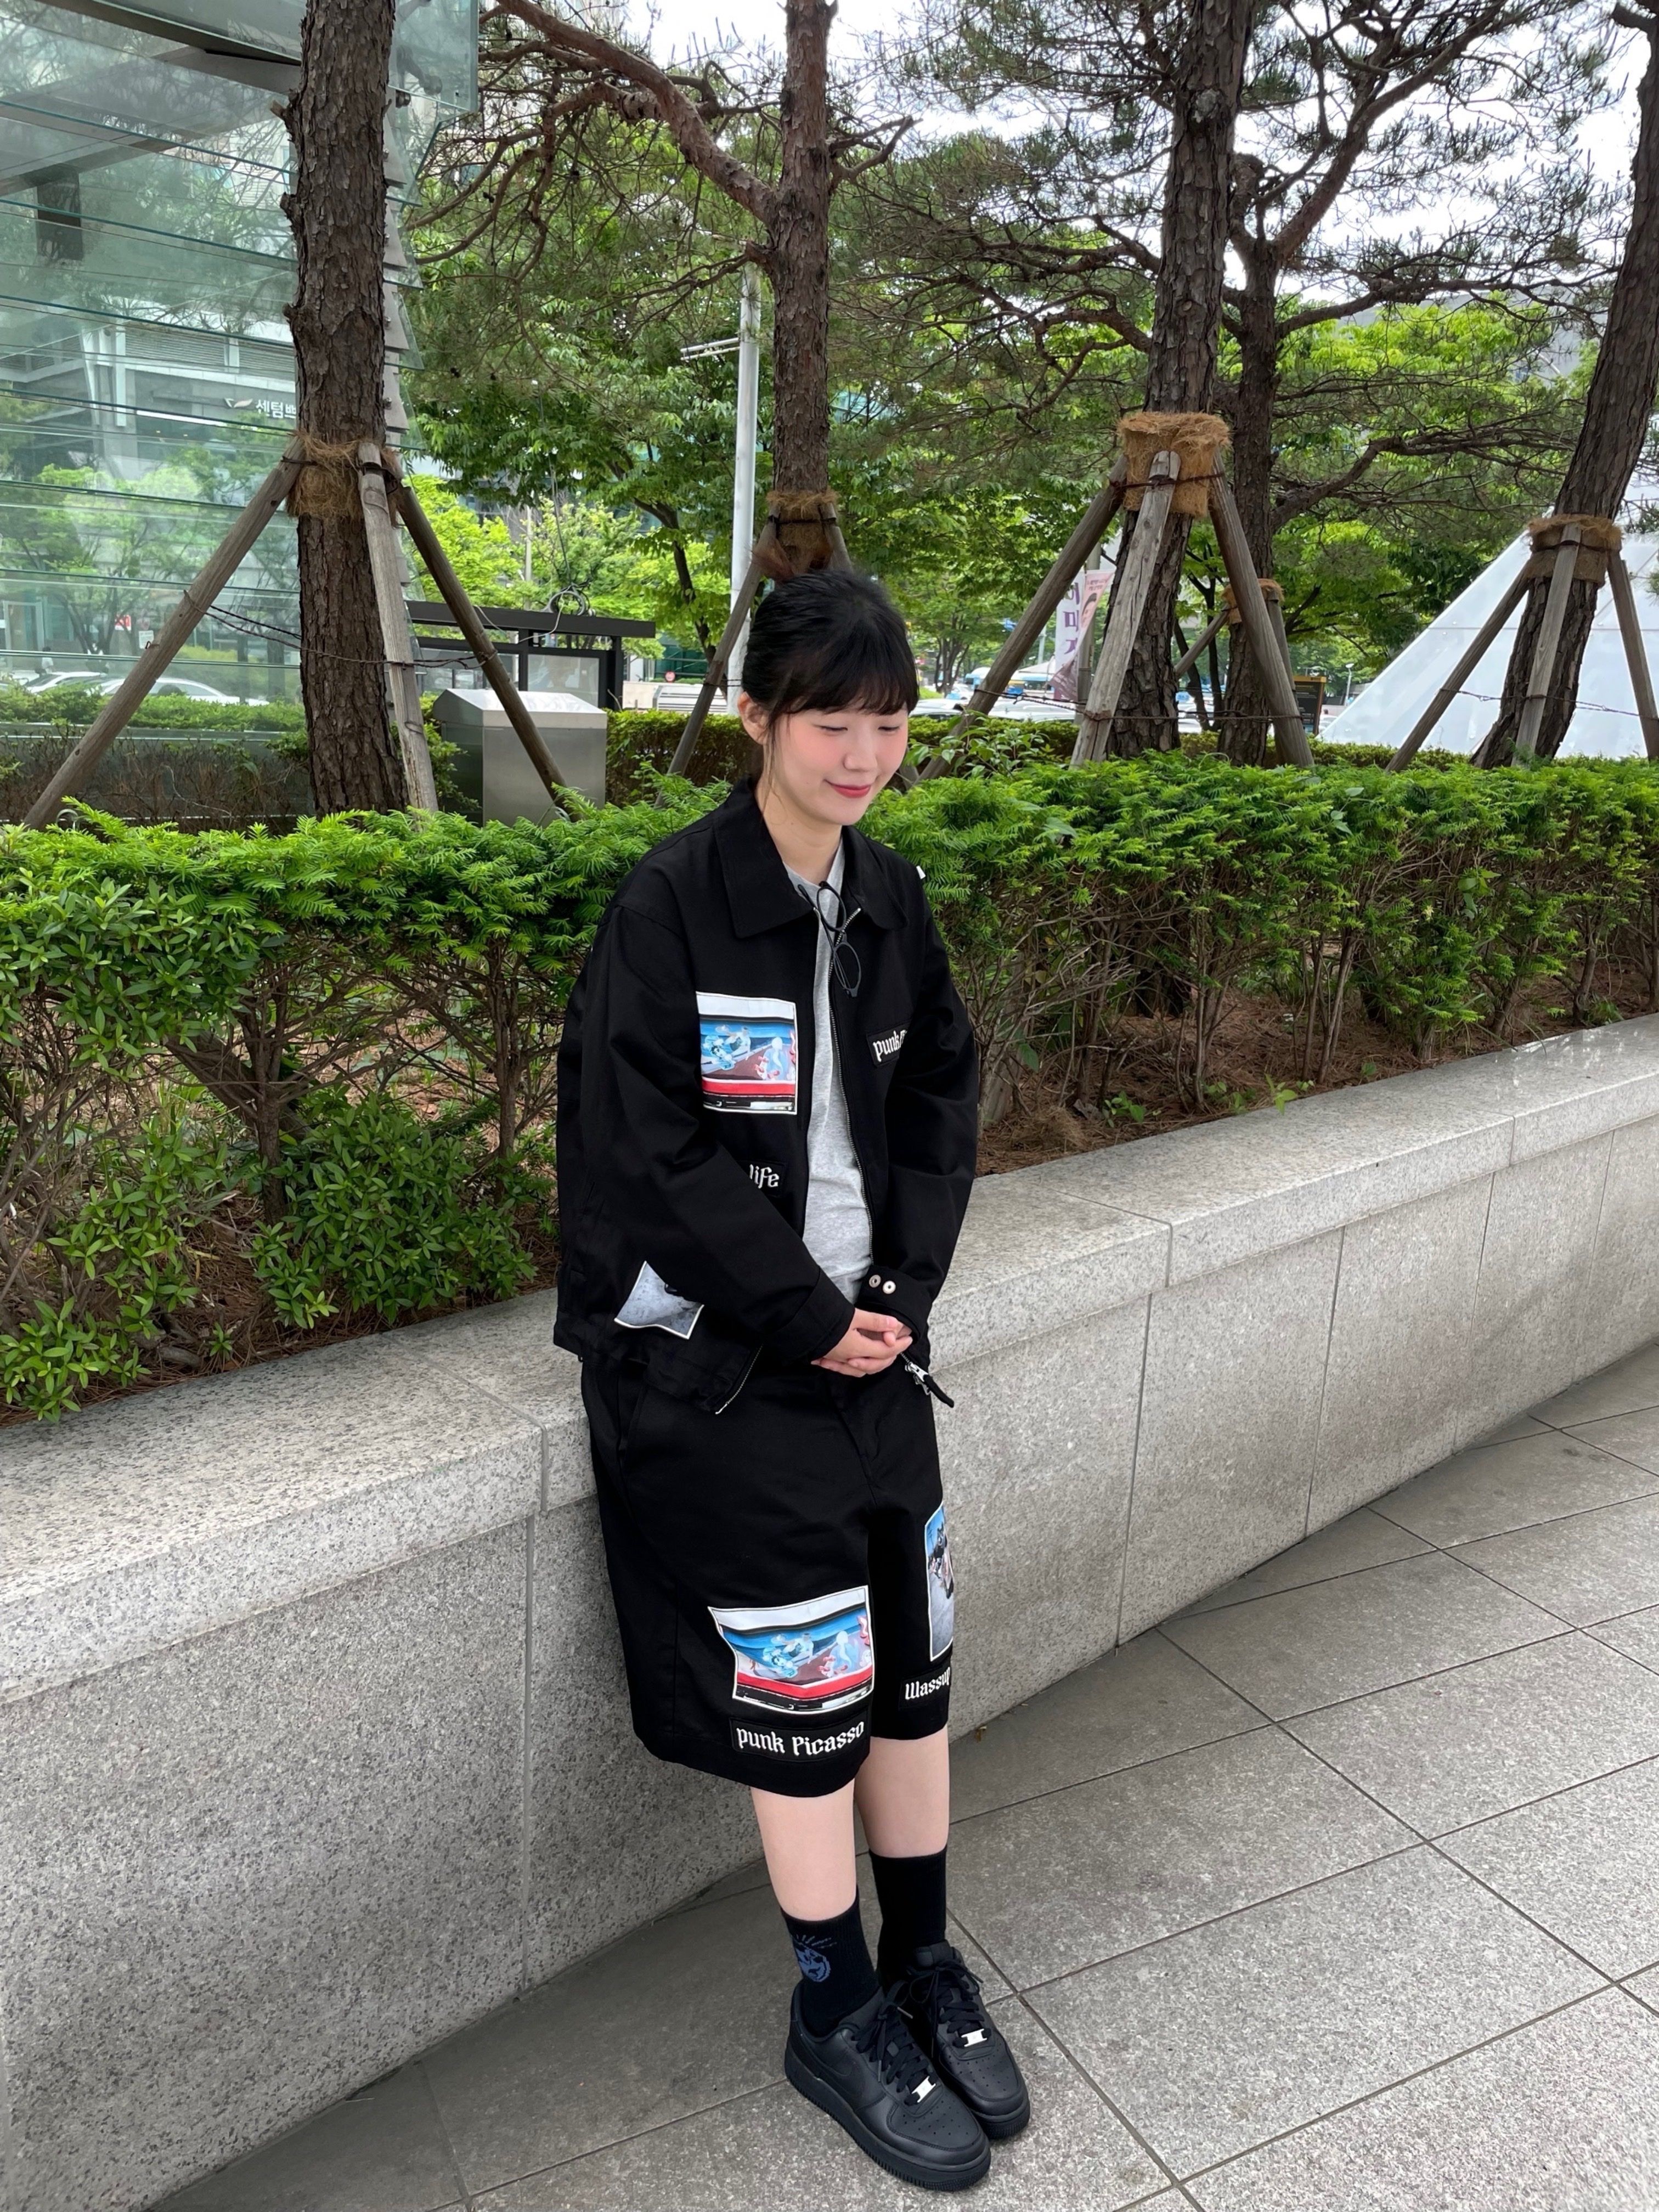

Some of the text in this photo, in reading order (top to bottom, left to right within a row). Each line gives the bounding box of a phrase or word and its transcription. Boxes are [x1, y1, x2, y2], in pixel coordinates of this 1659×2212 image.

[749, 1164, 780, 1189] life
[736, 1721, 865, 1756] punk Picasso
